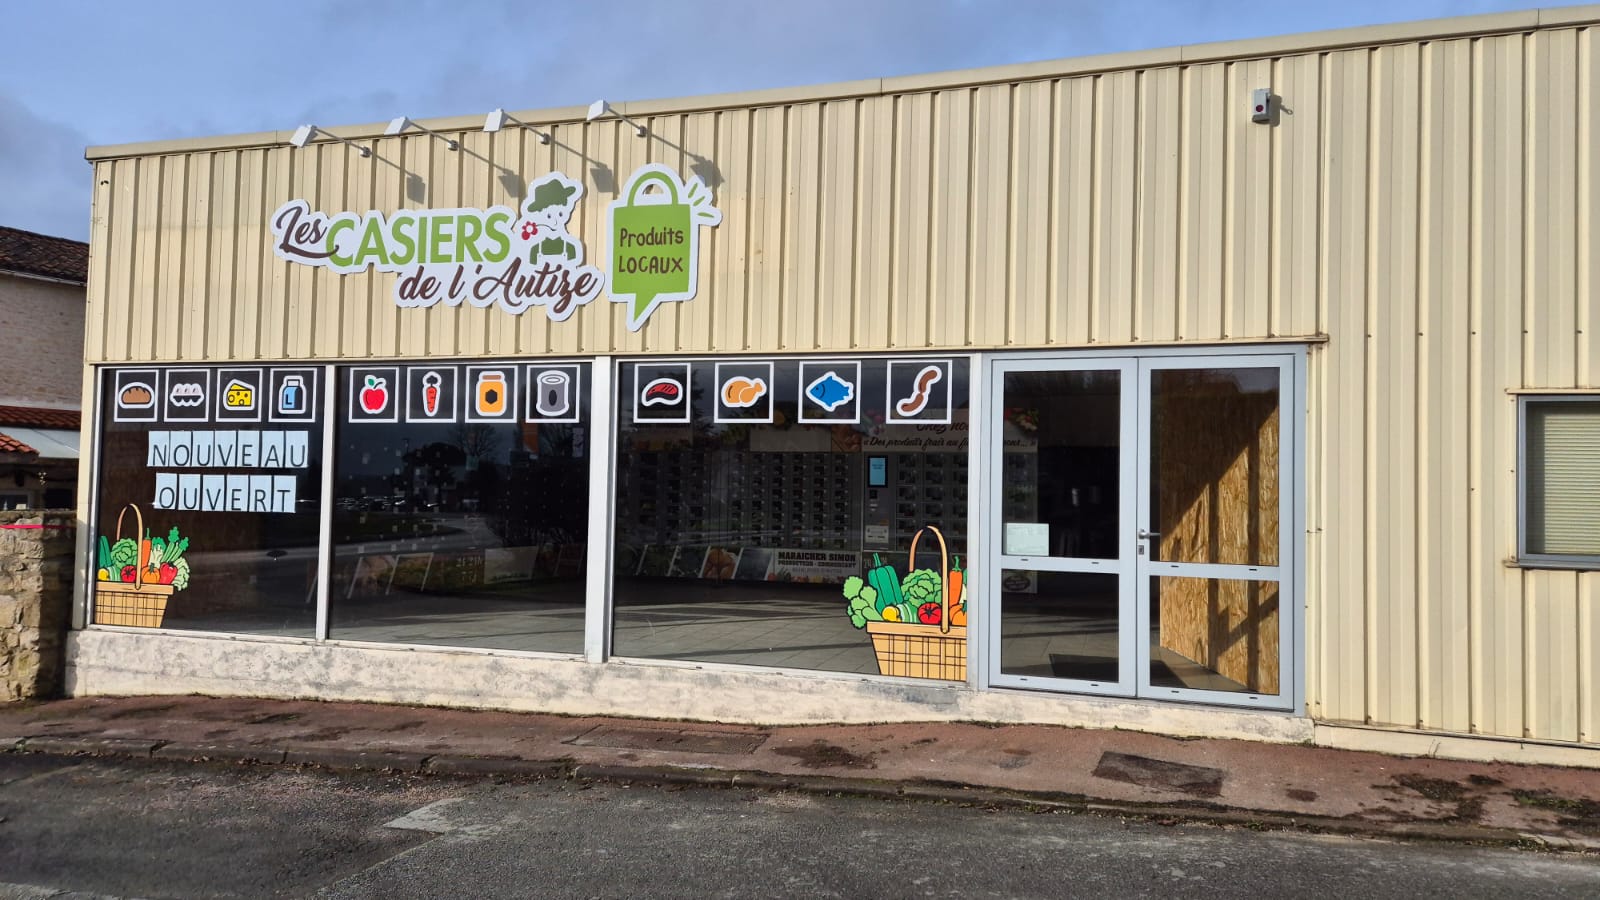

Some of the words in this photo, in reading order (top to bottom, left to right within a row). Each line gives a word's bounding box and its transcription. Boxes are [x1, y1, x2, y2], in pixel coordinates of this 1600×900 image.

[276, 206, 338, 259] Les
[326, 212, 511, 267] CASIERS
[619, 226, 684, 248] Produits
[618, 254, 684, 275] LOCAUX
[398, 266, 441, 301] de
[448, 257, 598, 313] l'Autize
[153, 443, 306, 468] NOUVEAU
[158, 486, 292, 512] OUVERT
[778, 552, 826, 561] MARAICHER
[829, 553, 856, 562] SIMON
